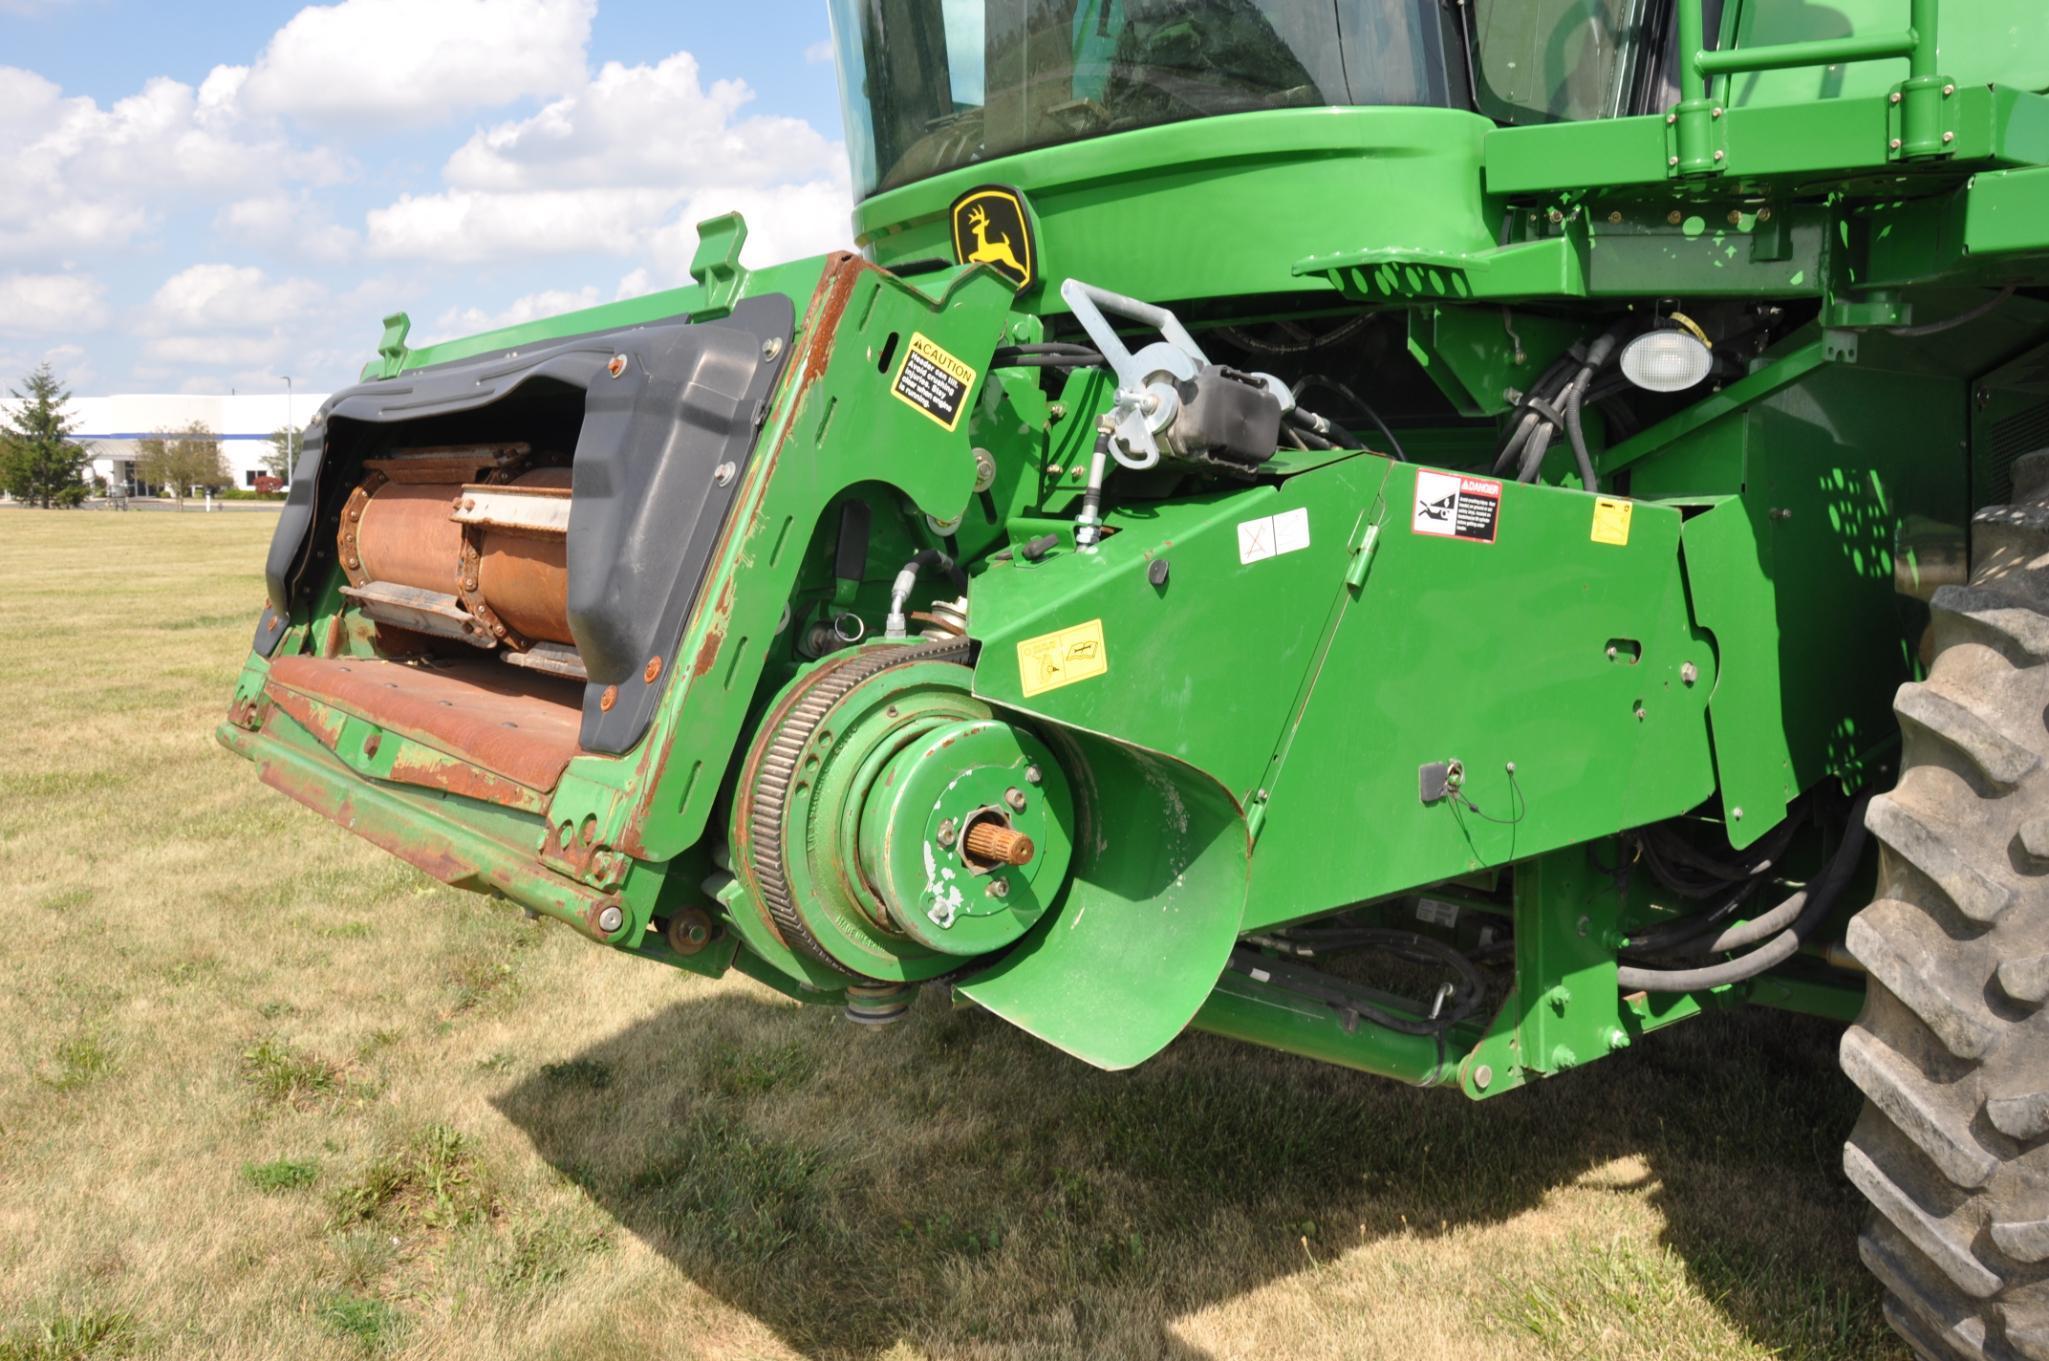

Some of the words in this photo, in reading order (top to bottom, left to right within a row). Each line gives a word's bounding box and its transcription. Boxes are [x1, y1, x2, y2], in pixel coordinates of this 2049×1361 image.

[908, 360, 927, 376] Avoid
[926, 373, 955, 396] crushing
[911, 352, 935, 372] Header
[934, 369, 947, 380] can
[923, 343, 972, 382] CAUTION
[902, 376, 917, 389] clear
[916, 384, 933, 399] when
[932, 396, 952, 412] engine
[931, 384, 946, 399] Stay
[1469, 482, 1498, 494] DANGER
